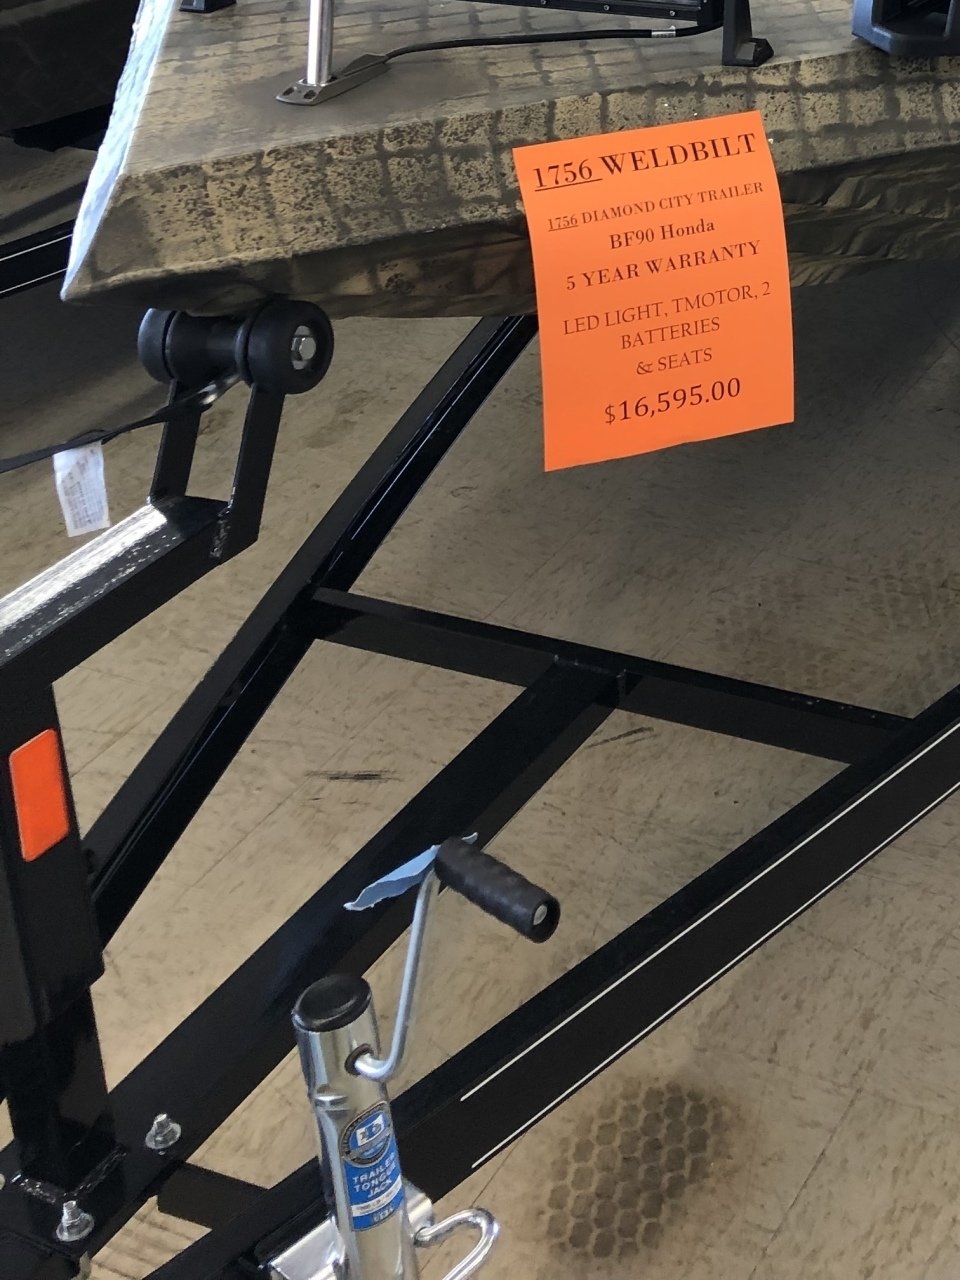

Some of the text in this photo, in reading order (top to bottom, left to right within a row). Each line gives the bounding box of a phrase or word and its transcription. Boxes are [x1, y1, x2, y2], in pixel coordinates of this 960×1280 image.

[533, 132, 756, 189] 1756 WELDBILT
[548, 181, 764, 231] 1756 DIAMOND CITY TRAILER
[609, 218, 715, 250] BF90 Honda
[566, 239, 761, 290] 5 YEAR WARRANTY
[563, 281, 771, 335] LED LIGHT, TMOTOR, 2
[621, 316, 720, 349] BATTERIES
[636, 347, 712, 375] & SEATS
[604, 377, 741, 424] $16,595.00
[368, 1179, 393, 1198] JACK
